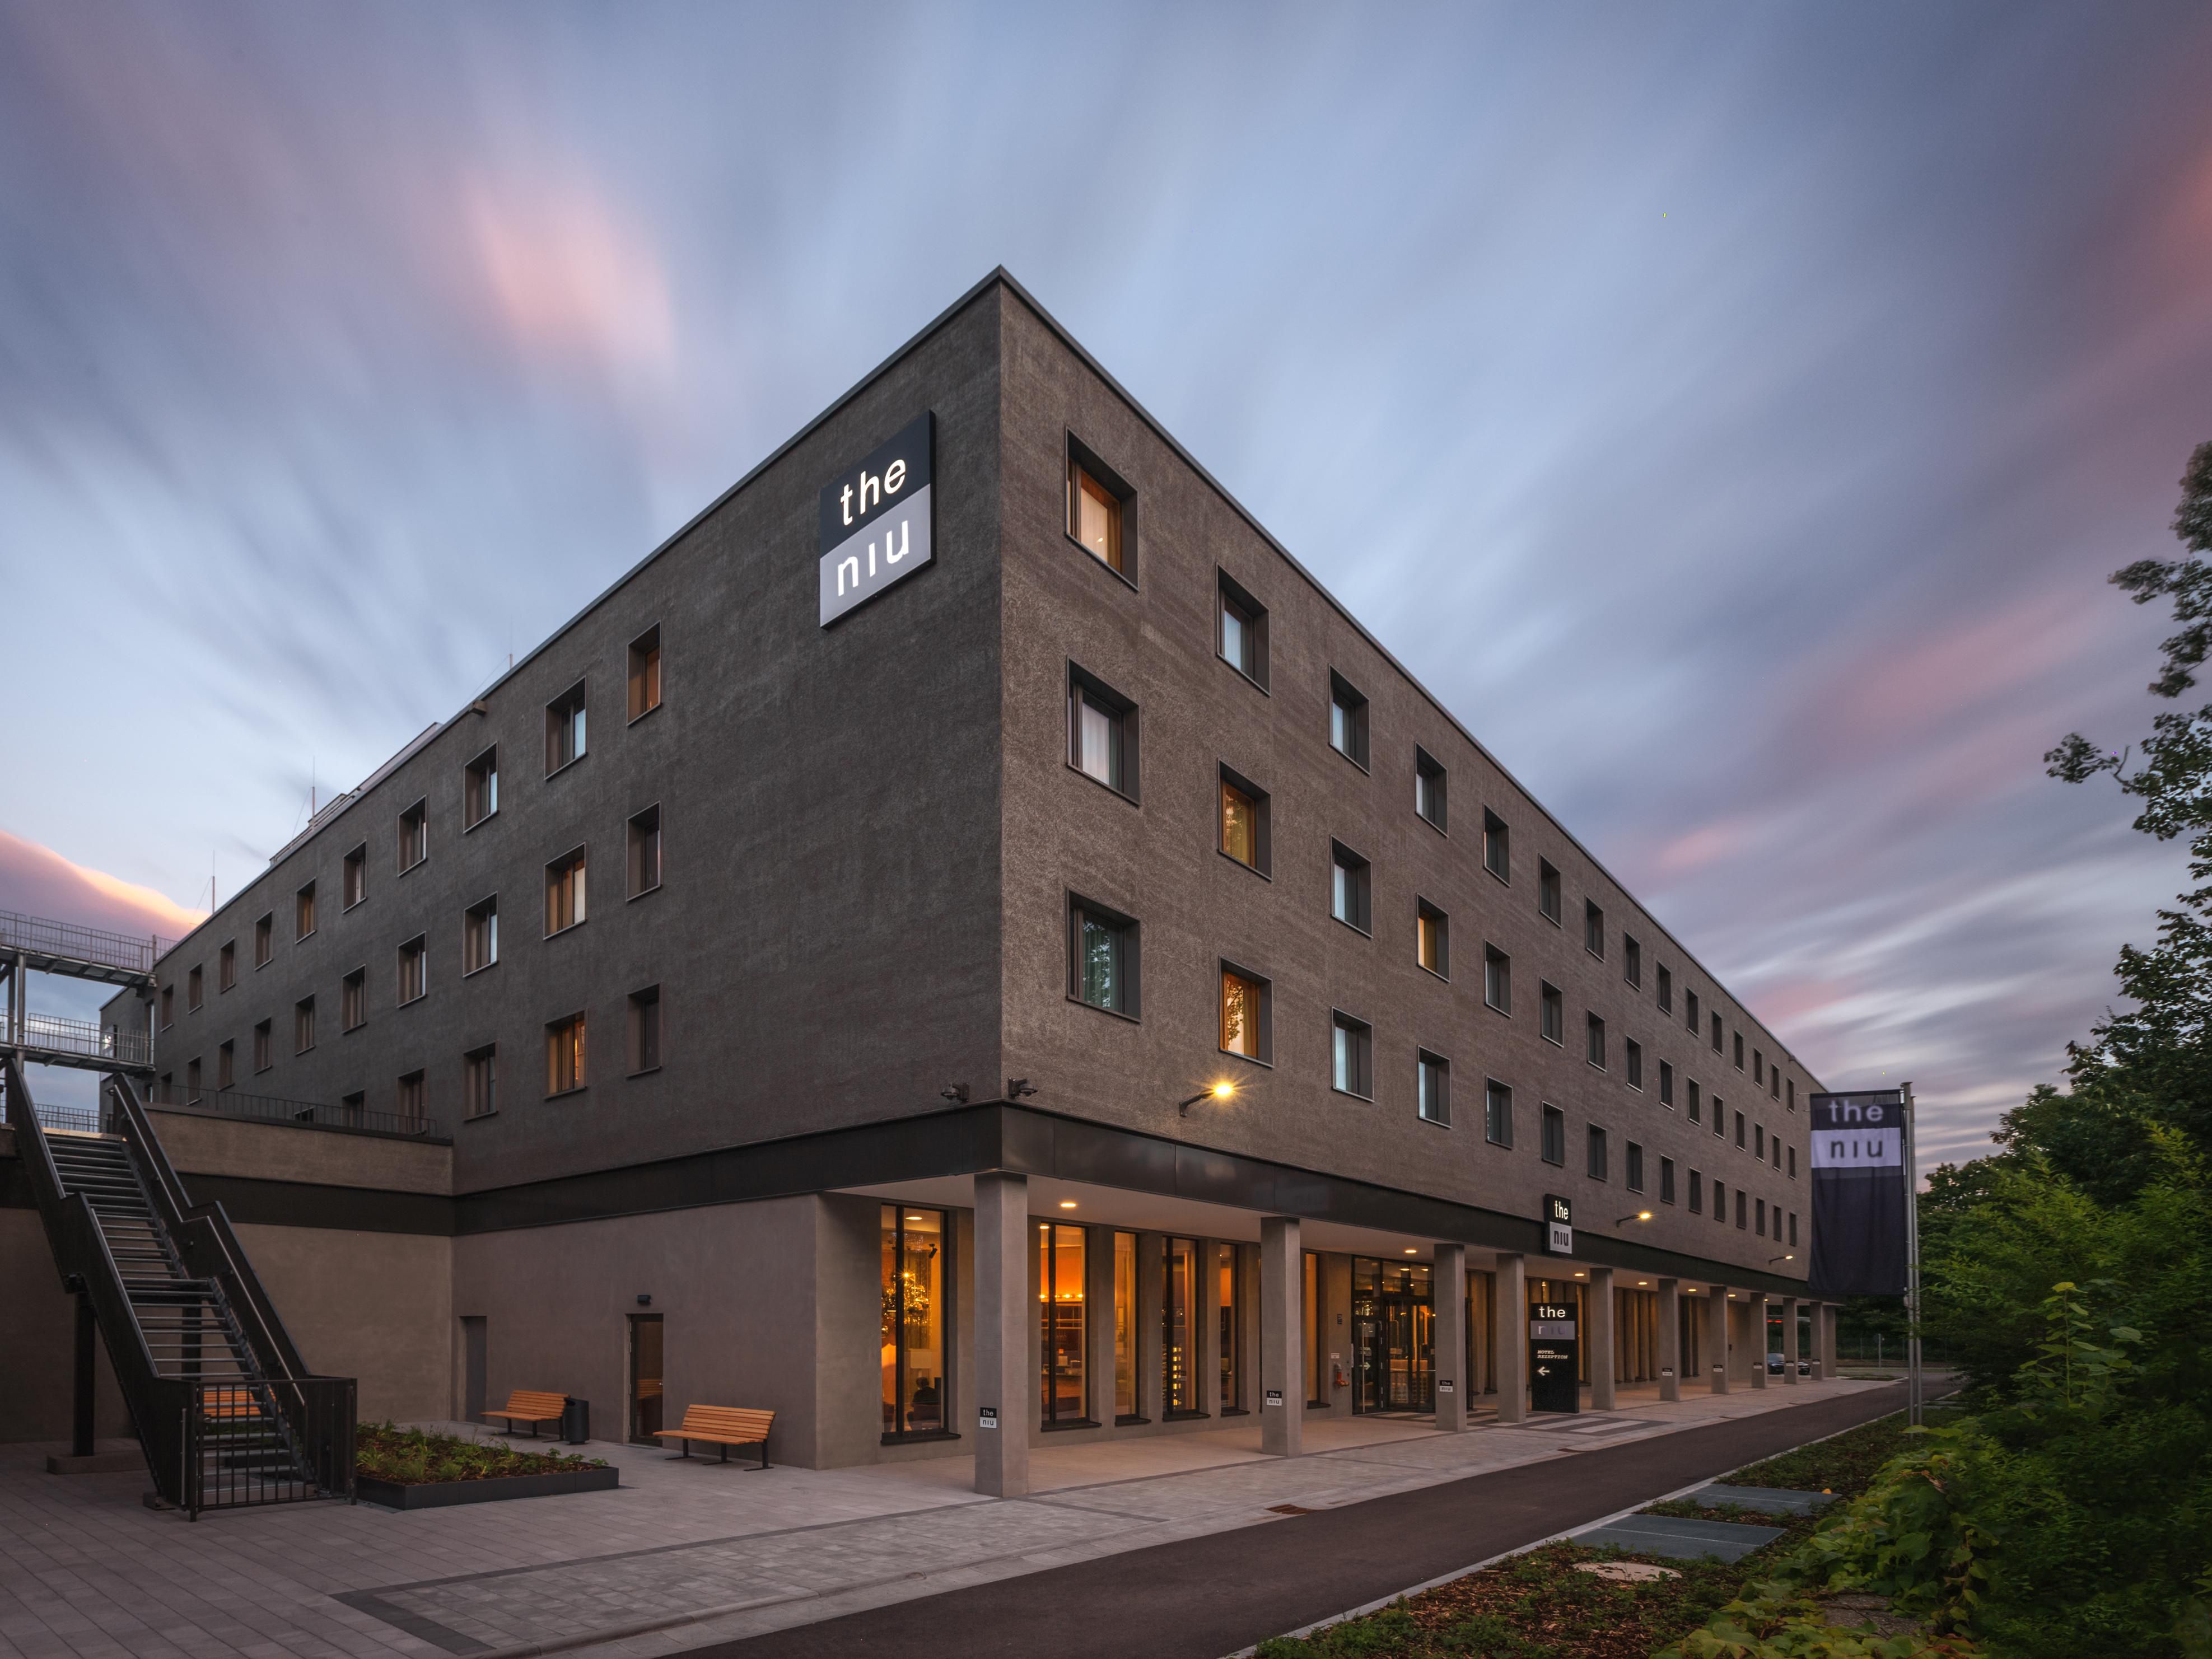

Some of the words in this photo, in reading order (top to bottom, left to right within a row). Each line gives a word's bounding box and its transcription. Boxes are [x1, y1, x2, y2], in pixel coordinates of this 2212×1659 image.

[841, 459, 906, 526] the
[838, 520, 909, 597] niu
[1828, 1099, 1883, 1123] the
[1830, 1139, 1883, 1158] niu
[1555, 1200, 1568, 1219] the
[1554, 1231, 1569, 1246] niu
[1538, 1306, 1566, 1317] the
